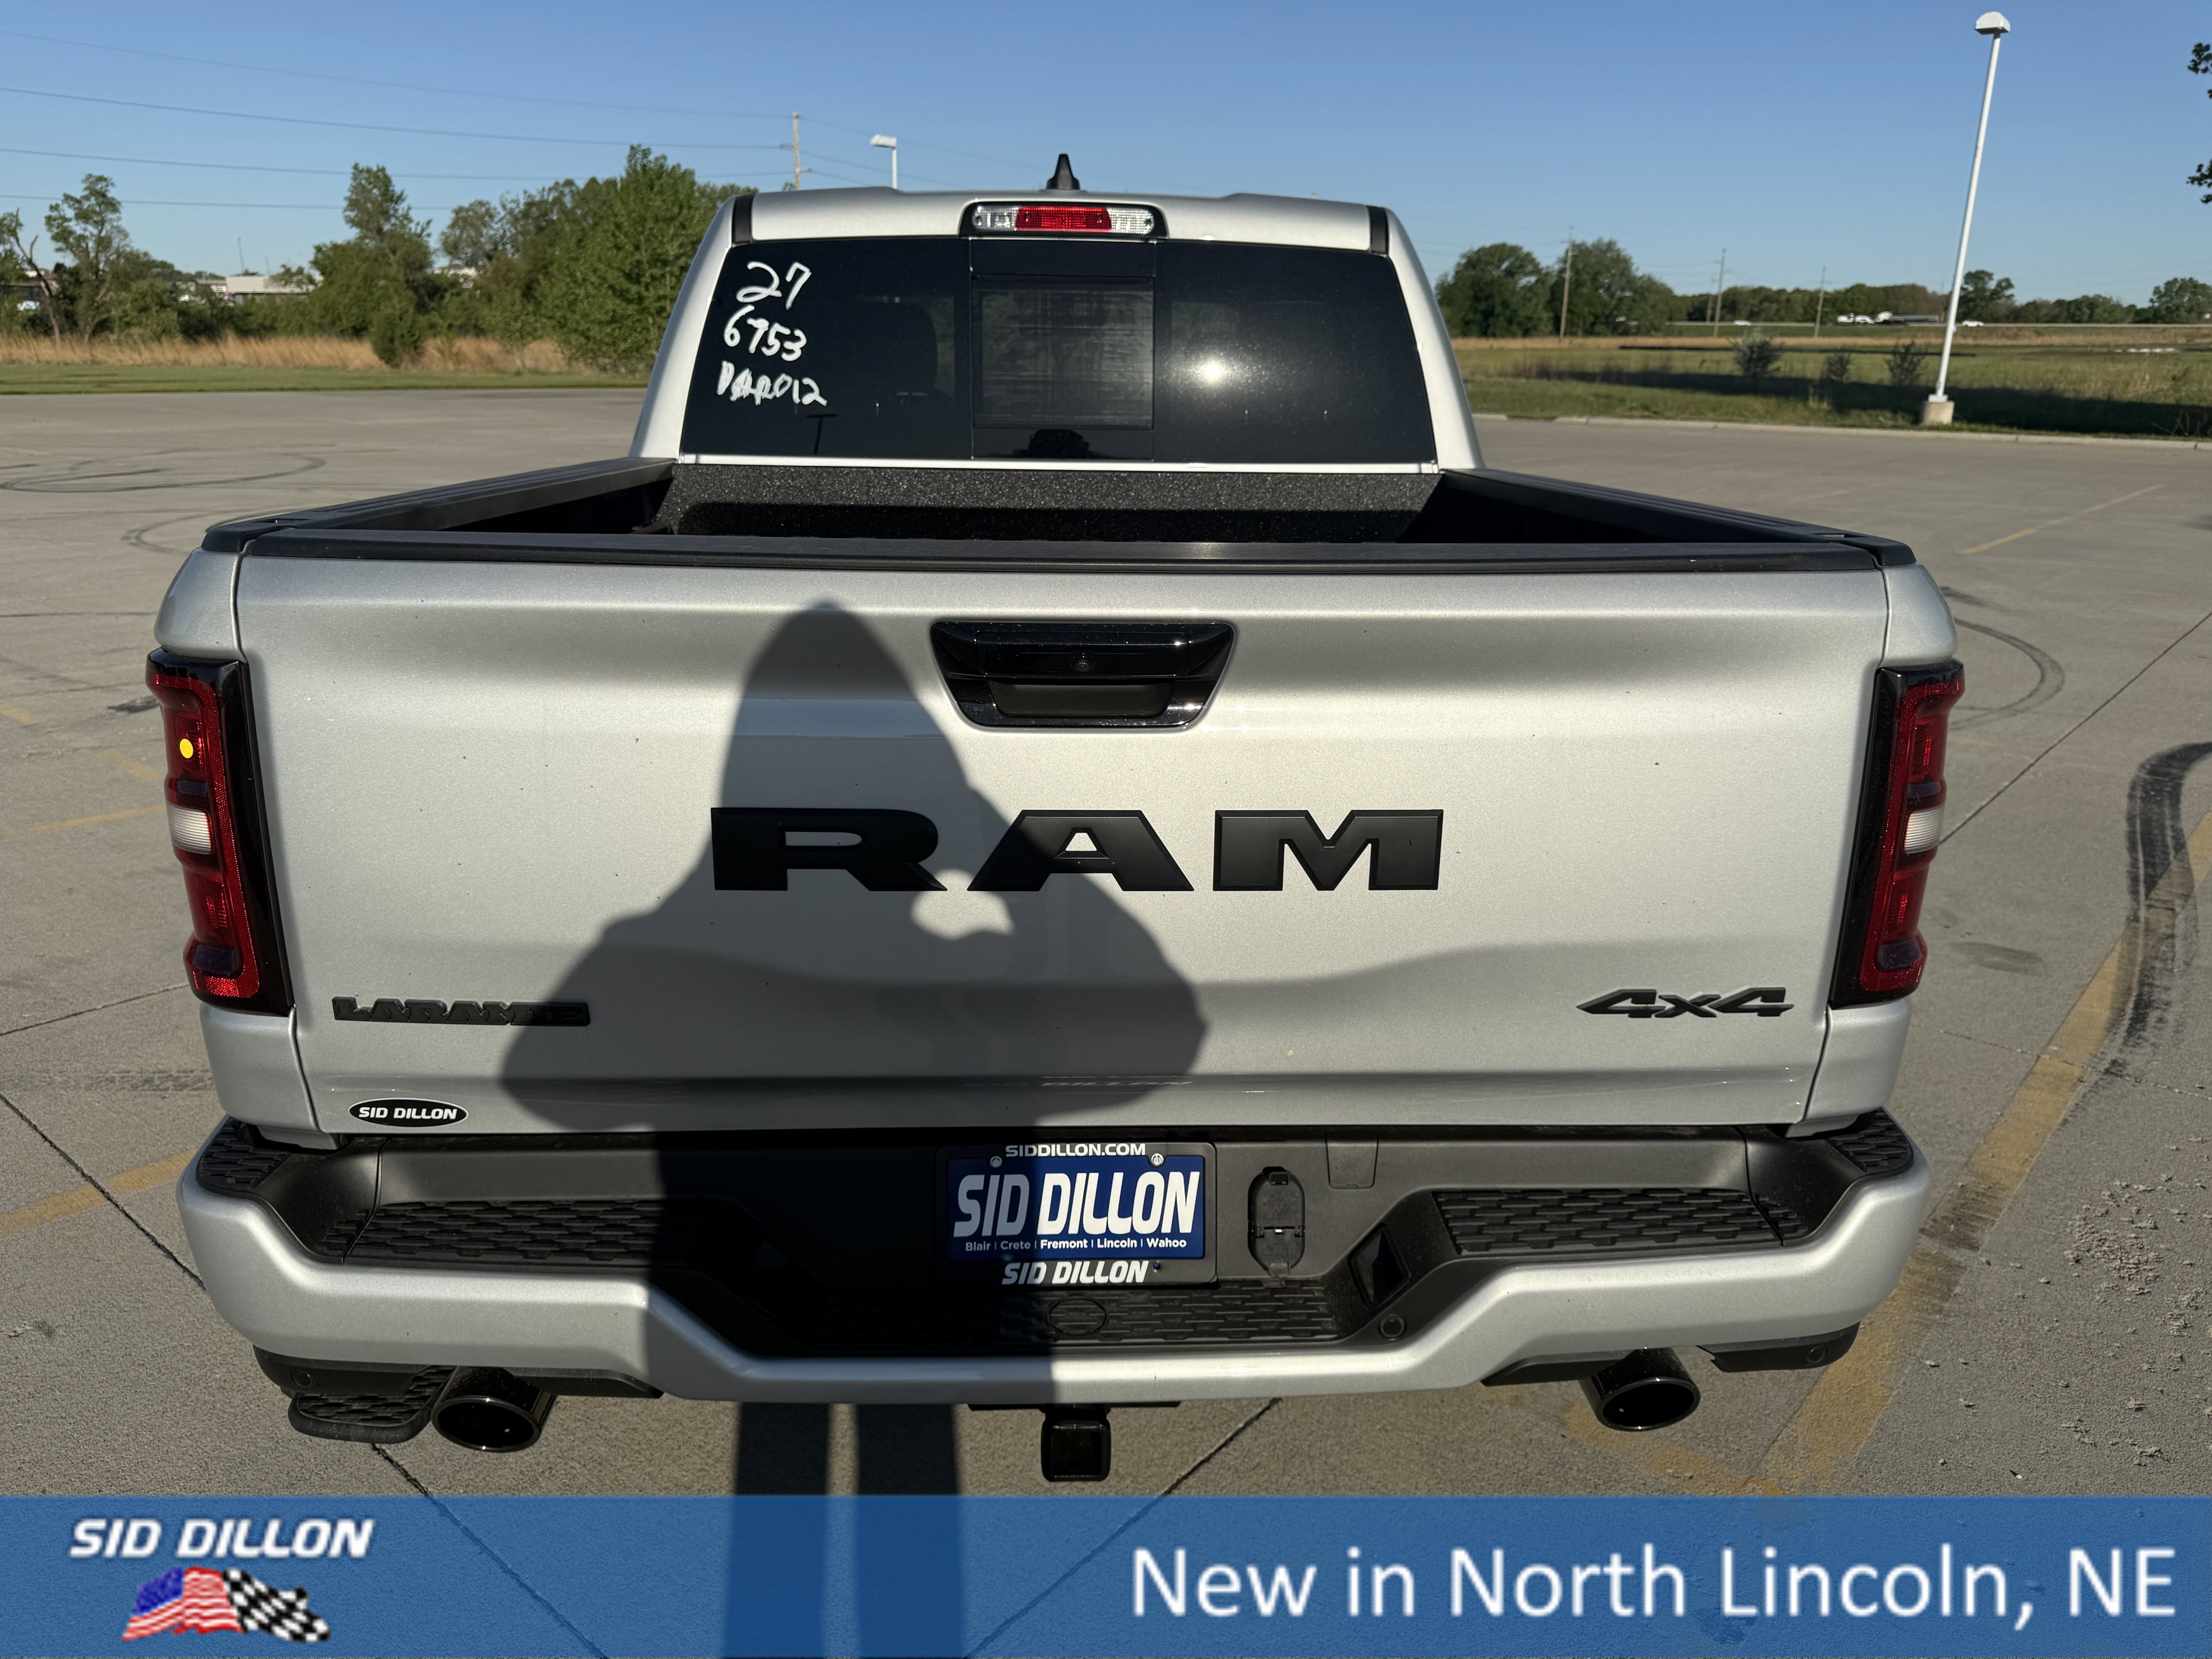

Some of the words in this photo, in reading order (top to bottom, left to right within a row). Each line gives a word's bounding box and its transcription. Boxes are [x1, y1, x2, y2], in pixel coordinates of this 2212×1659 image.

[736, 261, 812, 310] 27
[723, 304, 807, 362] 6753
[711, 807, 1444, 891] RAM
[332, 996, 591, 1027] LARAMIE
[359, 1107, 388, 1118] SID
[393, 1108, 457, 1120] DILLON
[1005, 1143, 1146, 1157] SIDDILLON.COM
[953, 1174, 1030, 1238] SID
[1037, 1171, 1200, 1235] DILLON
[965, 1242, 990, 1252] Blair
[1000, 1241, 1031, 1250] Crete
[1041, 1239, 1088, 1249] Fremont
[1097, 1238, 1137, 1249] Lincoln
[1146, 1238, 1187, 1248] Wahoo
[1002, 1262, 1046, 1285] SID
[1052, 1261, 1149, 1285] DILLON
